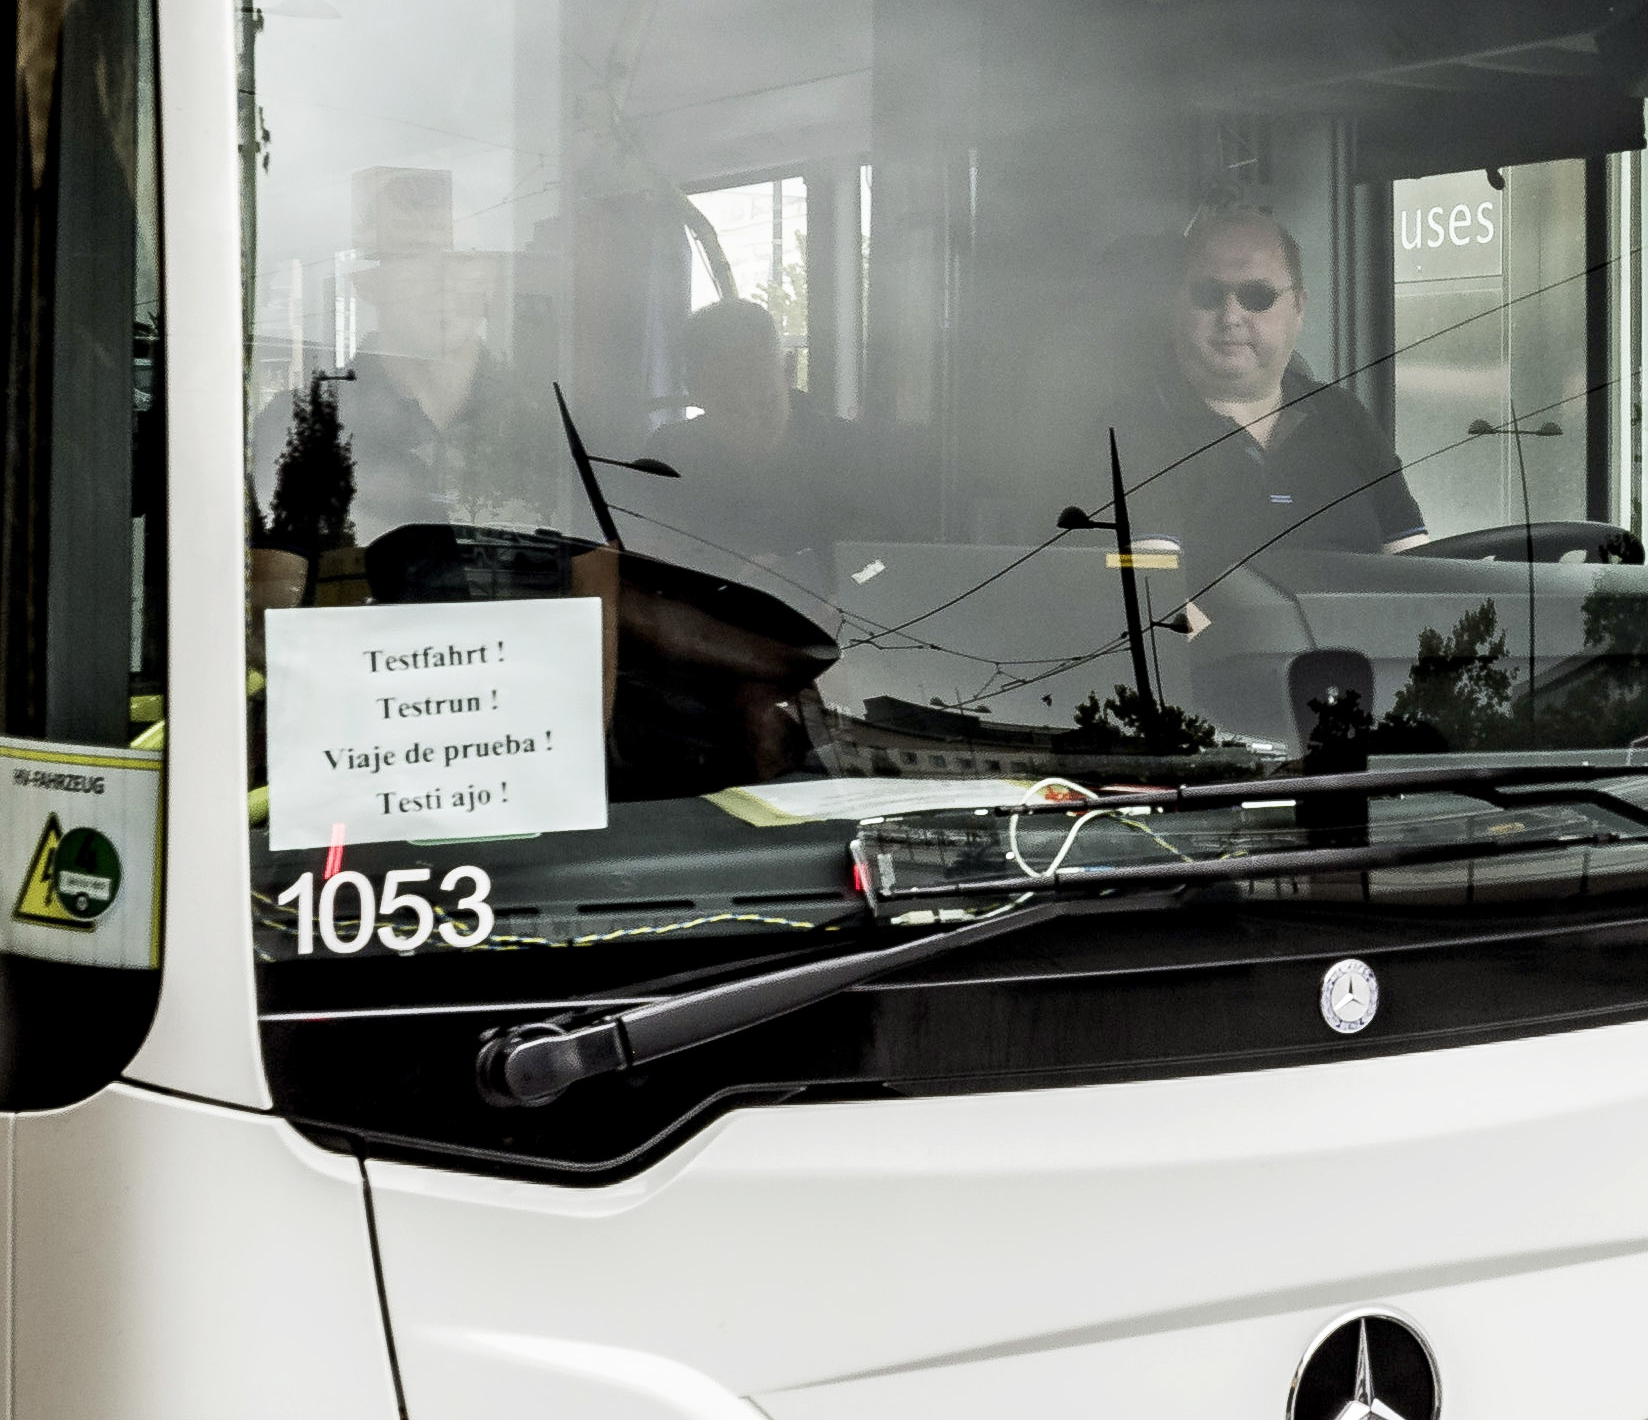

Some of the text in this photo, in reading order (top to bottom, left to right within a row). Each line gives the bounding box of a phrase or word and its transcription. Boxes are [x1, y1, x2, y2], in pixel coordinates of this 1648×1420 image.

[362, 640, 505, 673] Testfahrt !
[376, 689, 499, 720] Testrun !
[322, 730, 553, 774] Viaje de prueba !
[376, 781, 509, 816] Testi ajo !
[277, 864, 495, 956] 1053
